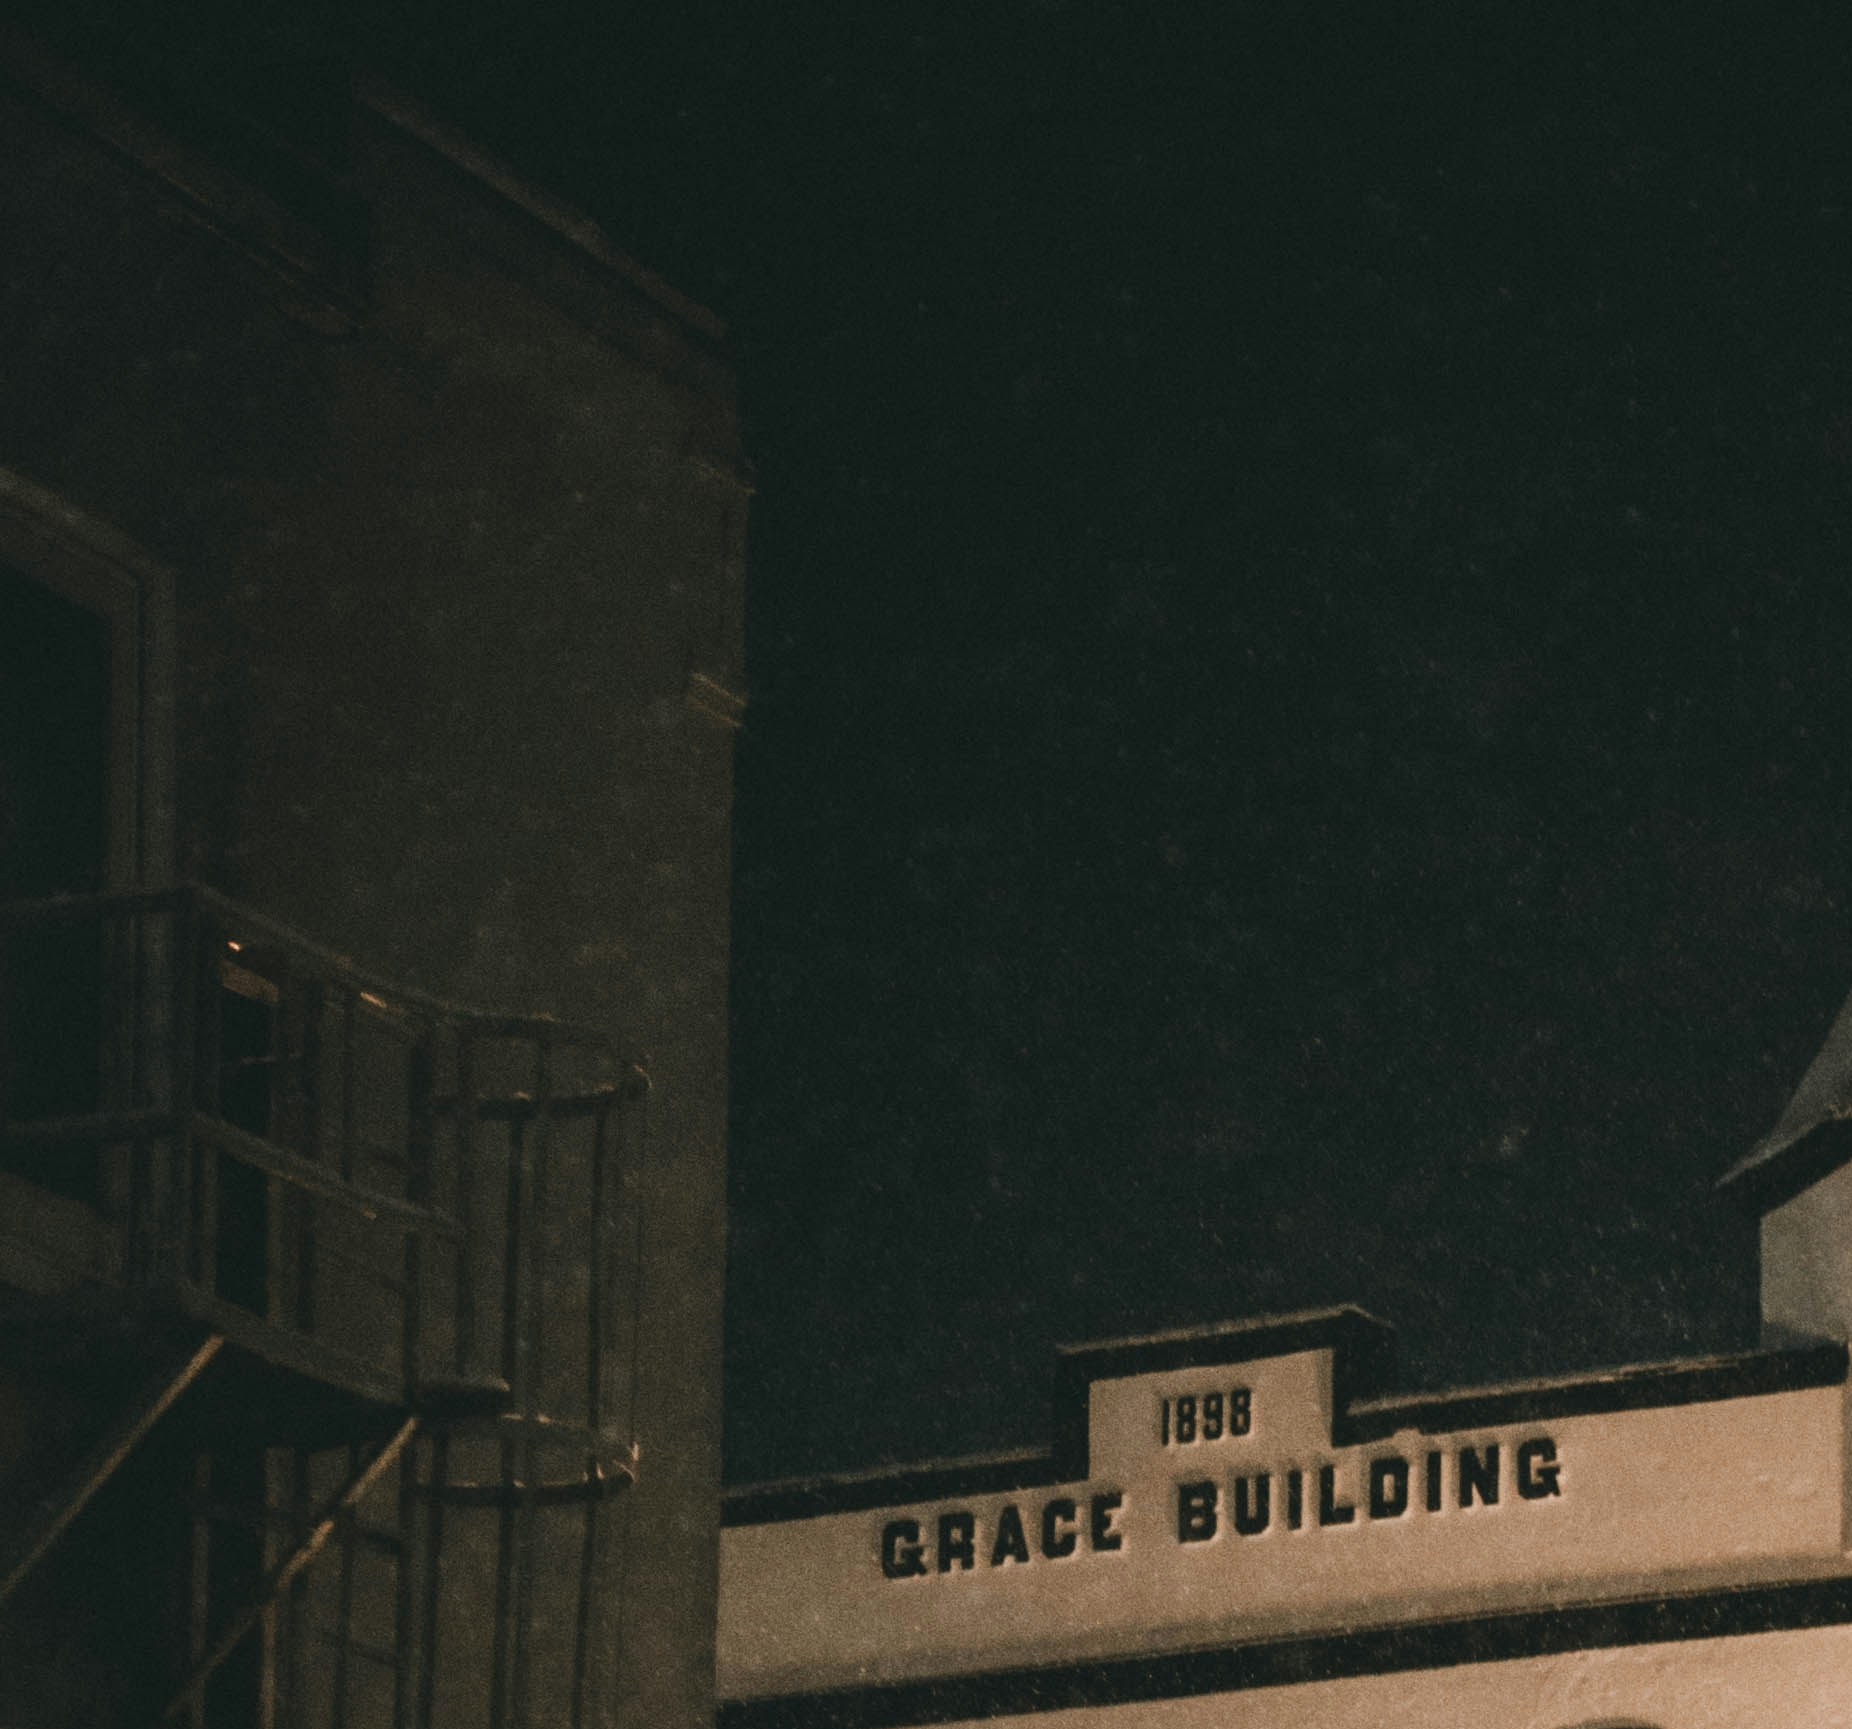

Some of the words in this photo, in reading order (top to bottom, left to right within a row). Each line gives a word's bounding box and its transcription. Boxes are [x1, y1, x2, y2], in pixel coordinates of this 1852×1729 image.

[1161, 1384, 1252, 1447] 1898
[881, 1490, 1123, 1580] GRACE
[1178, 1436, 1561, 1545] BUILDING
